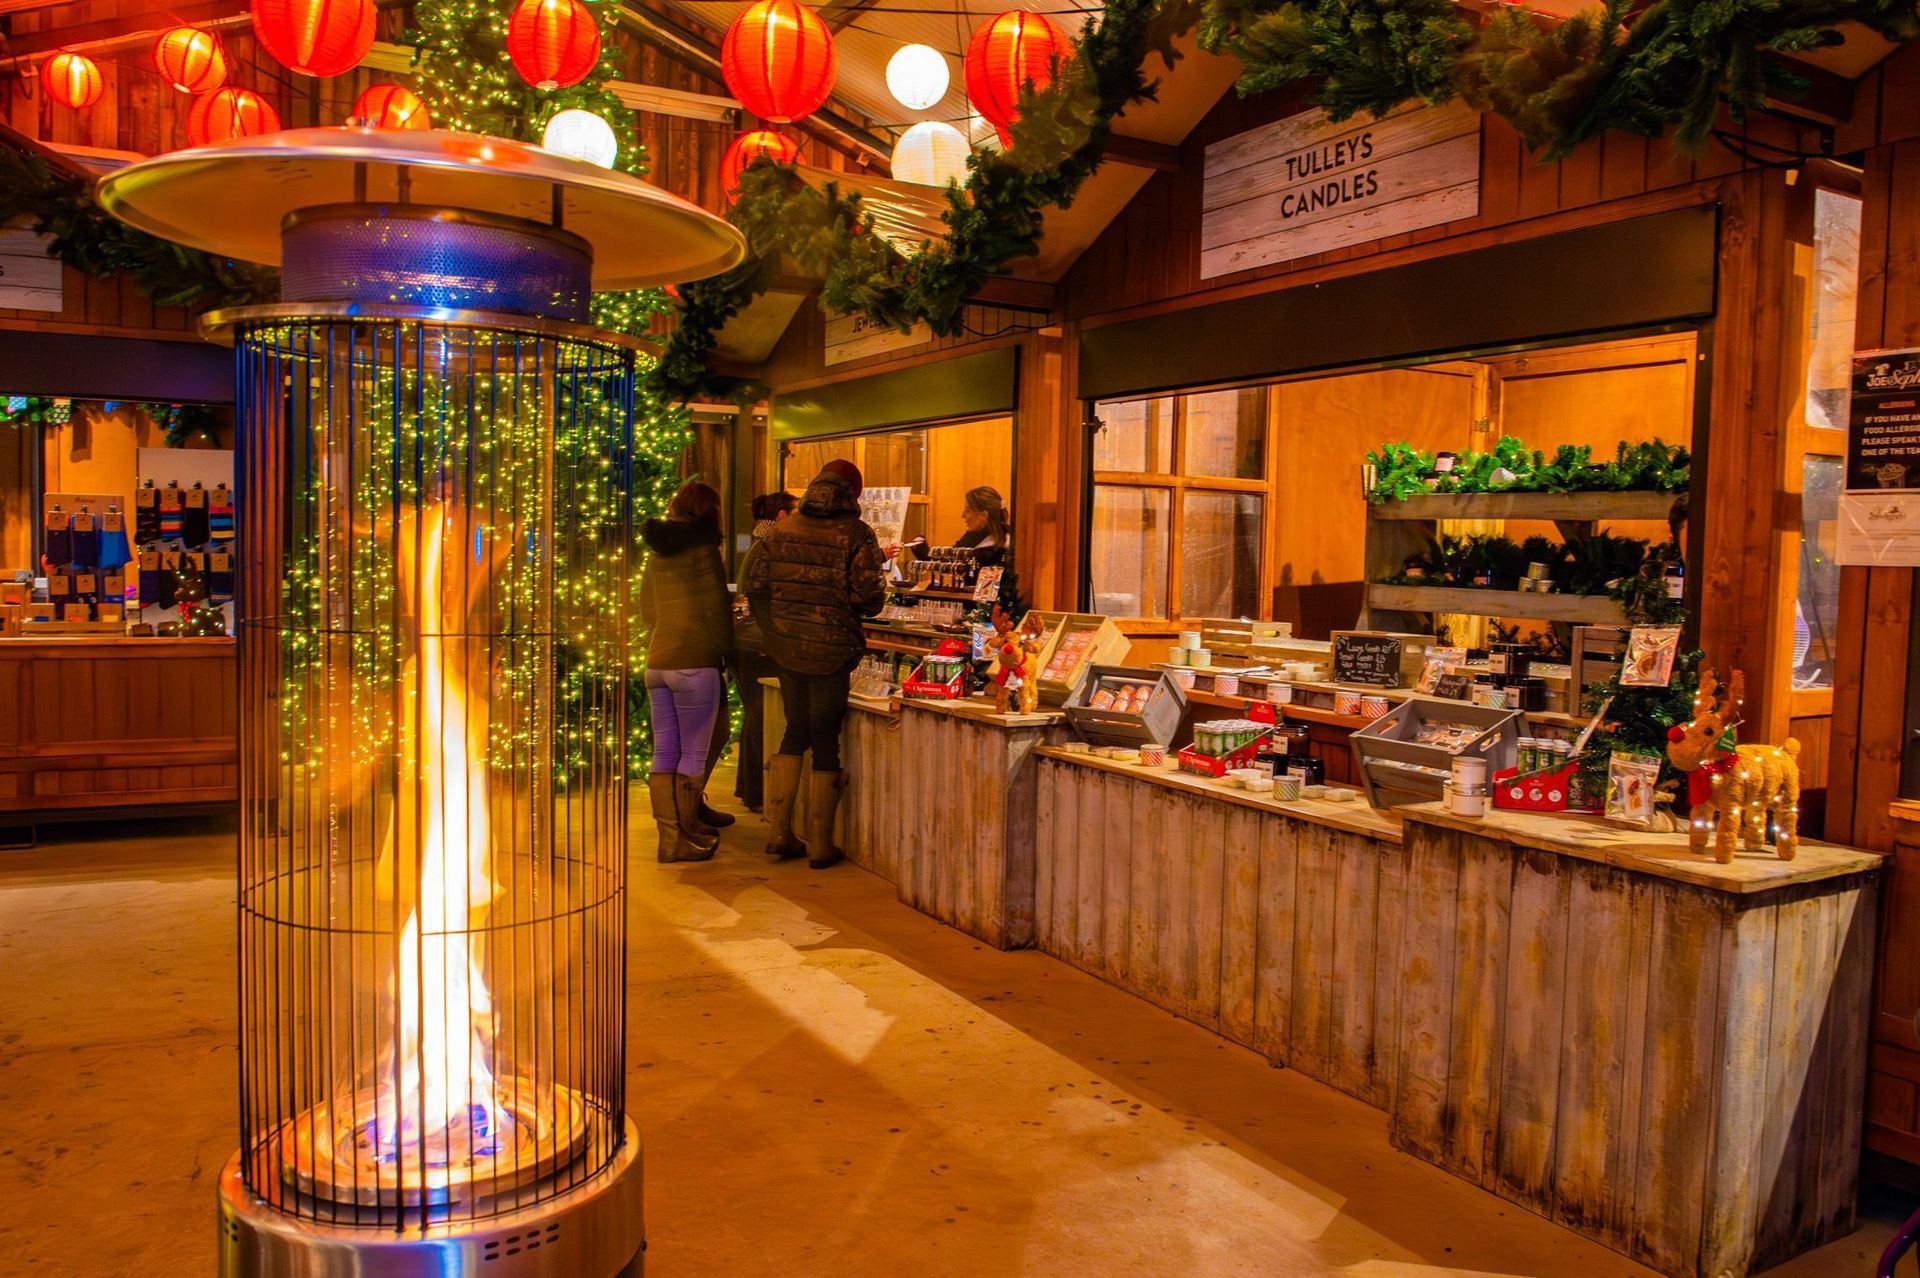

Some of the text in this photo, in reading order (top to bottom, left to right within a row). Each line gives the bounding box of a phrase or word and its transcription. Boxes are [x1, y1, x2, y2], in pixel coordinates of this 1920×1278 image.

[1286, 133, 1373, 181] TULLEYS
[1281, 170, 1378, 219] CANDLES
[1874, 415, 1889, 423] YOU
[1890, 414, 1911, 422] HAVE
[1863, 426, 1885, 434] FOOD
[1891, 436, 1916, 444] SPEAK
[1878, 448, 1889, 456] OF
[1890, 447, 1905, 455] THE
